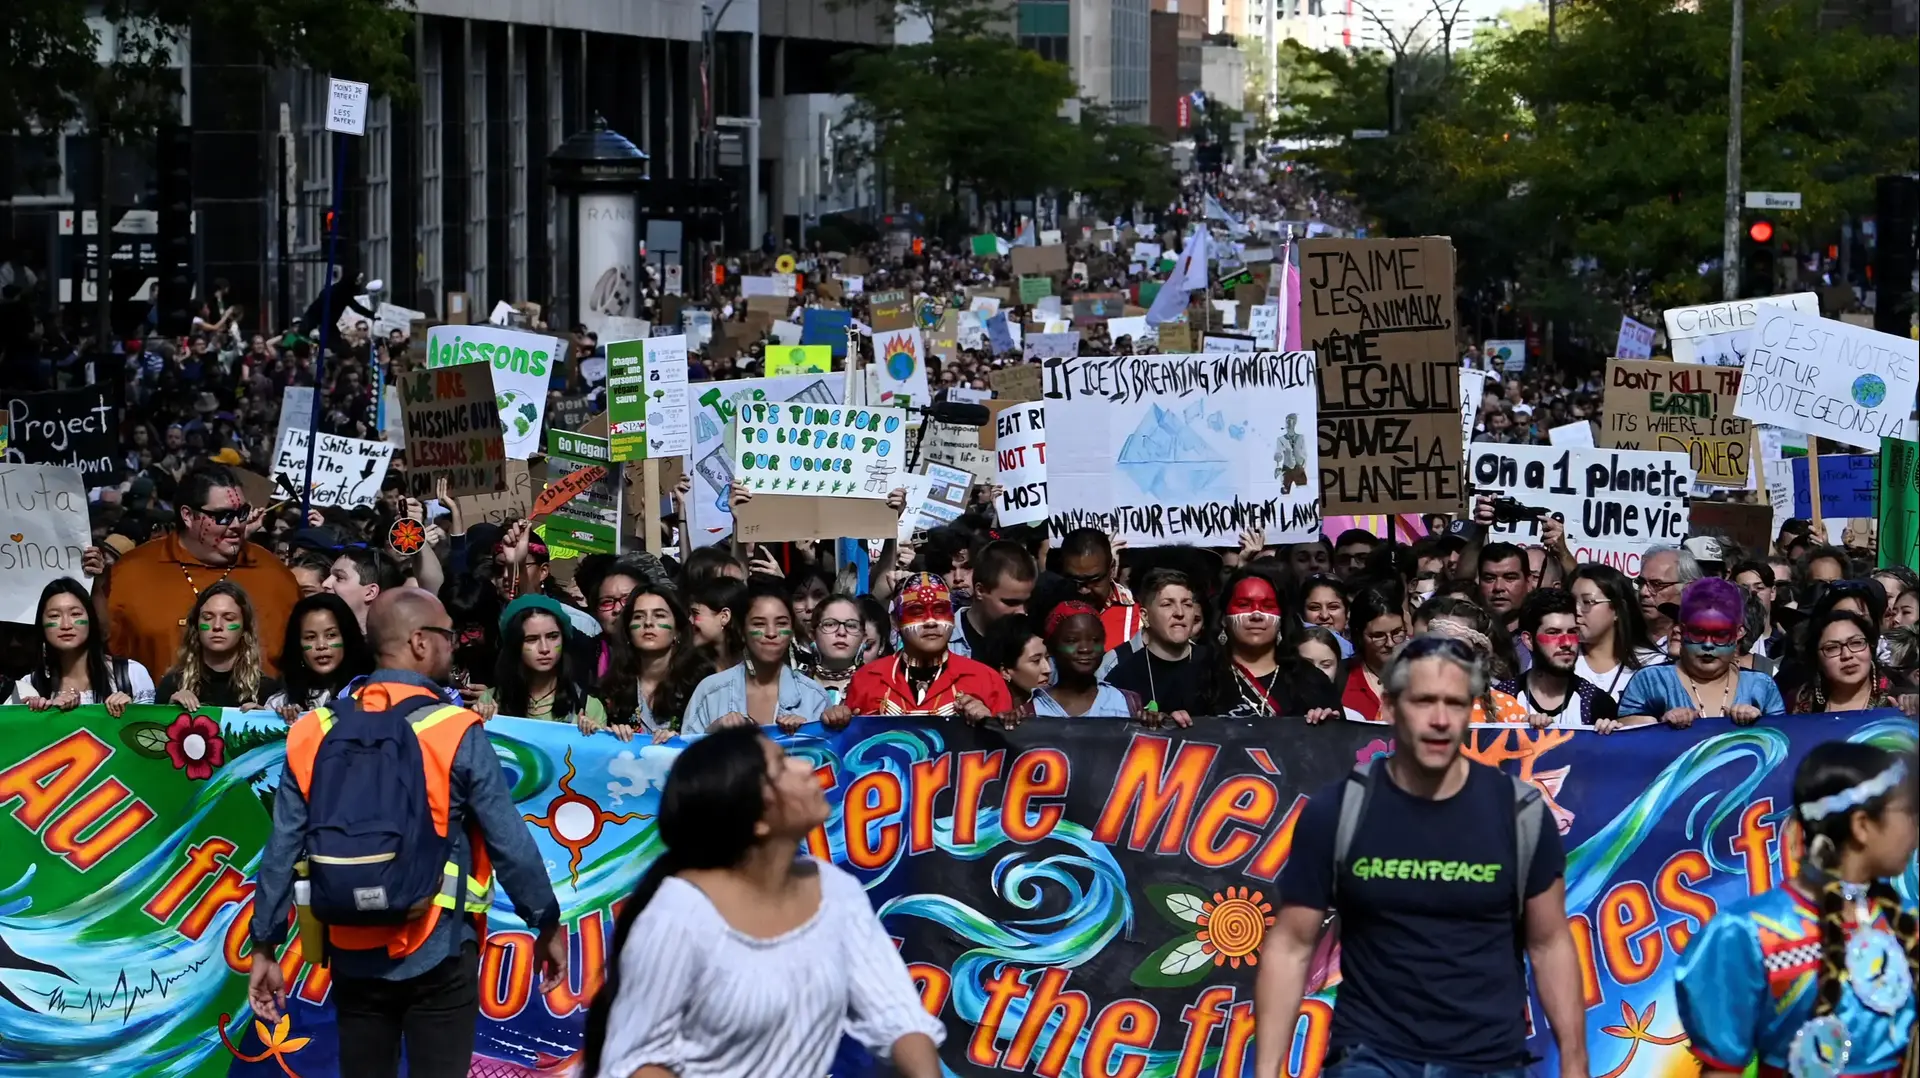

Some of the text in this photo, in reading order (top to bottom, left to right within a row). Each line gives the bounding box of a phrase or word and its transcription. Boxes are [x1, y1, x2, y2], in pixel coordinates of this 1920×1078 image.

[333, 108, 351, 118] LESS
[1308, 249, 1424, 292] J'AIME
[1313, 285, 1364, 316] LES
[612, 356, 638, 368] Chaque
[1312, 328, 1382, 367] MÊME
[1837, 336, 1914, 383] NOTRE
[610, 375, 642, 387] personne
[627, 366, 641, 374] une
[1044, 357, 1082, 401] IF
[1080, 360, 1109, 397] ICE
[1130, 357, 1210, 403] BREAKING
[1210, 354, 1231, 394] IN
[1613, 366, 1662, 391] DON'T
[1669, 370, 1711, 394] KILL
[1750, 349, 1820, 388] FUTUR
[436, 371, 467, 399] ARE
[615, 395, 637, 404] sauve
[1317, 362, 1459, 412] LEGAULT
[9, 394, 112, 451] Project
[407, 404, 469, 438] MISSING
[742, 402, 900, 433] IT'S TIME FOR U
[997, 412, 1021, 439] EAT
[1612, 412, 1637, 432] IT'S
[1646, 416, 1704, 436] WHERE
[1721, 418, 1748, 436] GET
[320, 435, 353, 455] Shits
[558, 437, 572, 451] Go
[742, 427, 768, 444] TO
[776, 427, 856, 451] LISTEN
[861, 437, 891, 457] TO
[1317, 418, 1413, 459] SAUVEZ
[1413, 436, 1445, 468] LA
[316, 454, 344, 474] The
[411, 440, 468, 468] LESSONS
[742, 451, 853, 474] OUR VOICES
[960, 451, 976, 463] life
[981, 452, 990, 463] is
[998, 446, 1026, 472] NOT
[540, 477, 574, 506] IDLE
[575, 465, 605, 491] MORE
[1524, 460, 1545, 489] a
[1550, 450, 1577, 495] 1
[1585, 453, 1688, 498] planète
[1280, 499, 1320, 534] LAWS
[0, 727, 158, 874] Au
[1352, 857, 1502, 883] GREENPEACE
[967, 964, 1160, 1078] the
